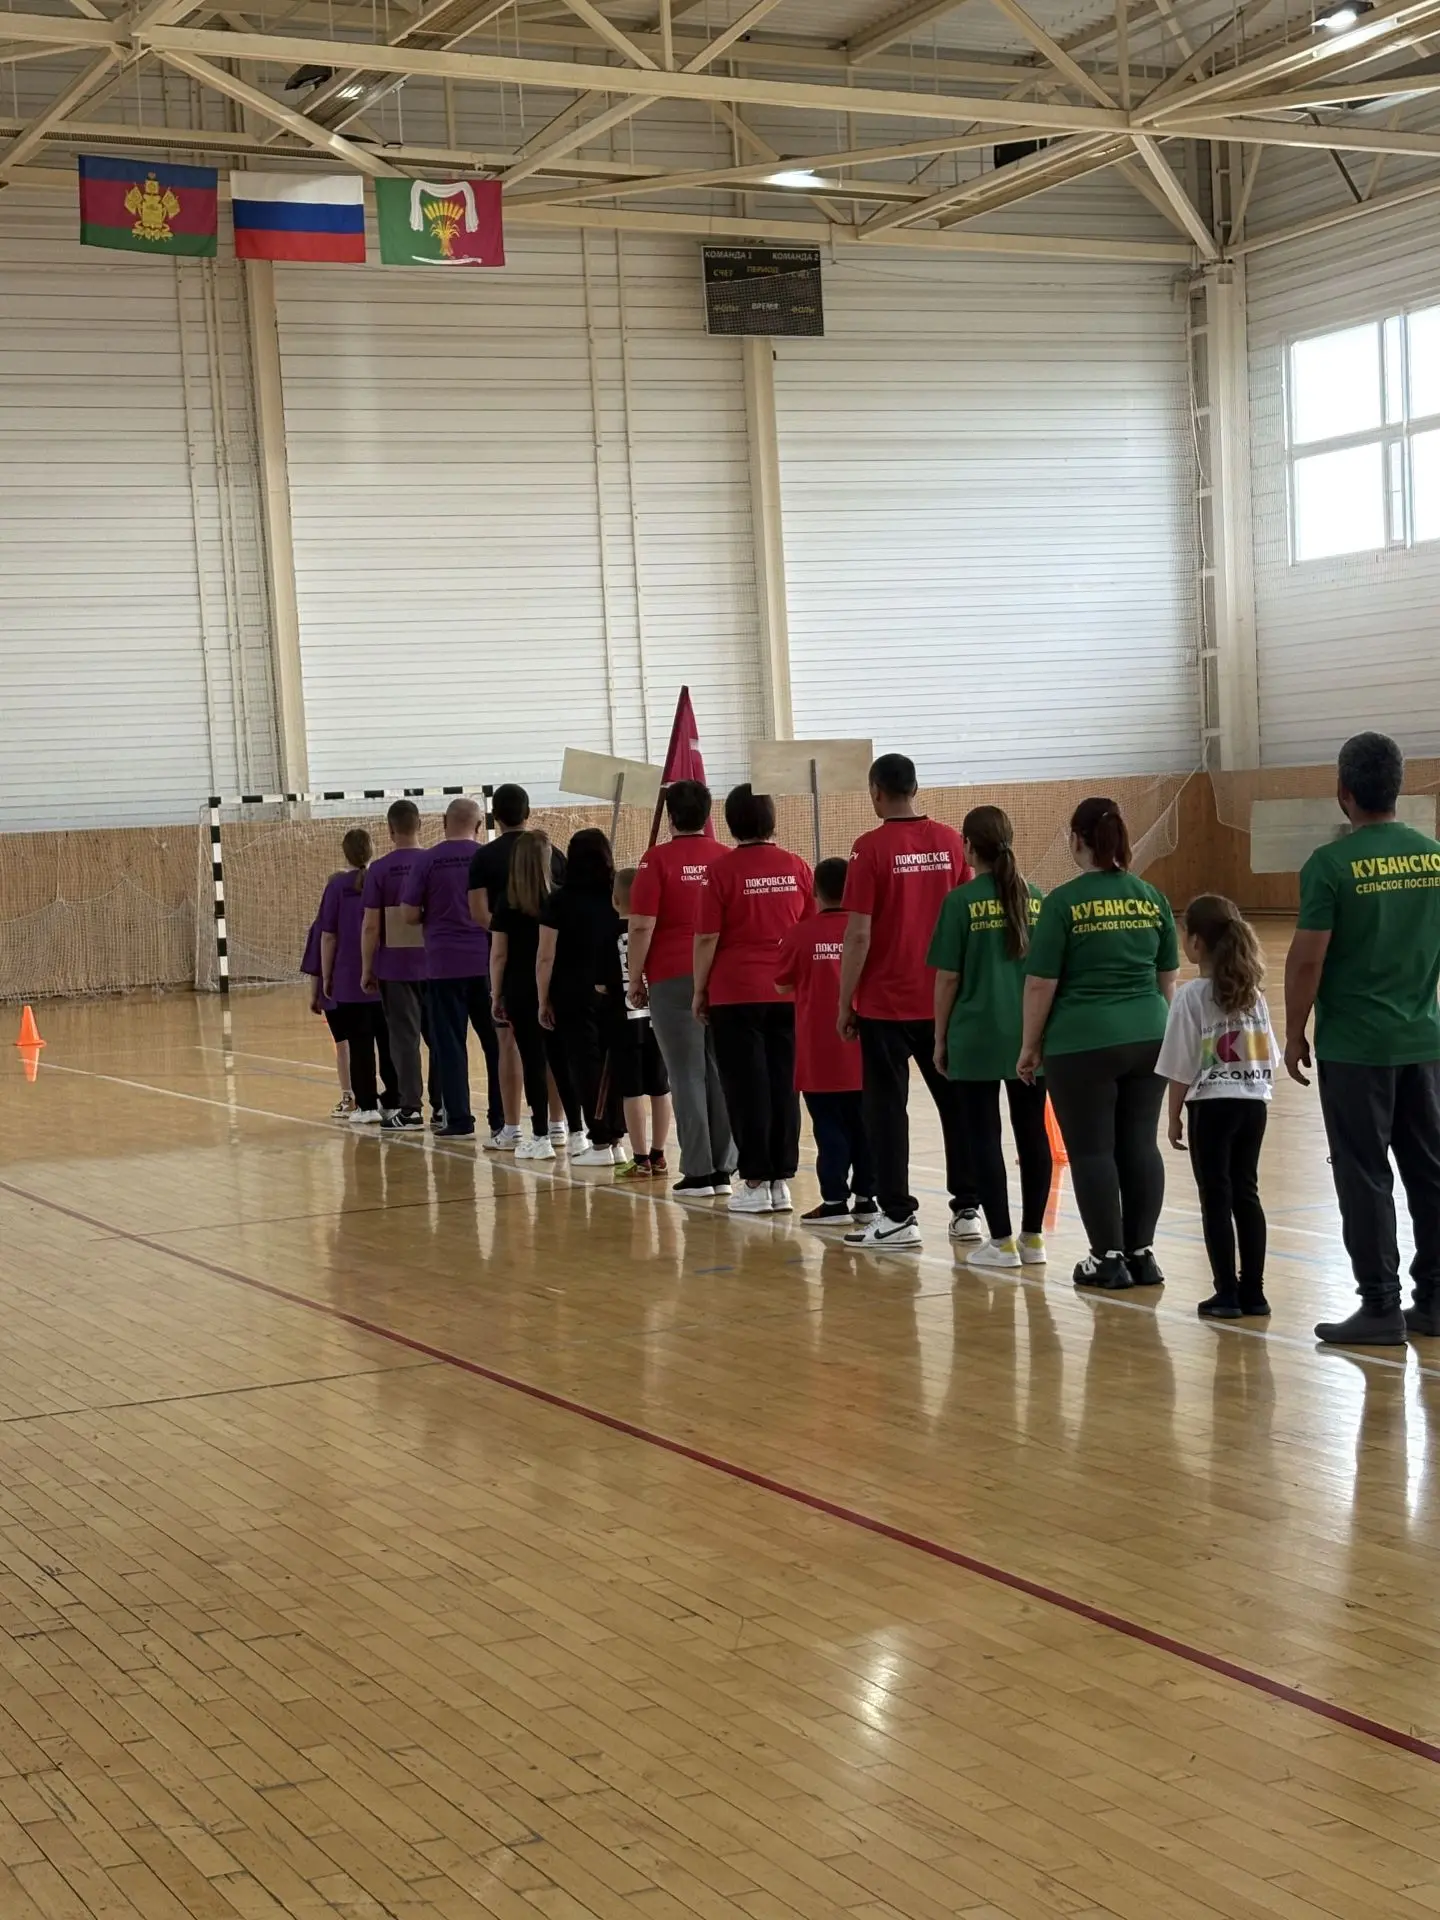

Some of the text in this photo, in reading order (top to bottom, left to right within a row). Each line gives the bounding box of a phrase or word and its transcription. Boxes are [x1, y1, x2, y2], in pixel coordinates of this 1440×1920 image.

[705, 250, 745, 259] КОМАНДА
[772, 252, 812, 260] КОМАНДА
[751, 302, 779, 310] ВРЕМЯ
[895, 851, 950, 865] ПОКРОВСКОЕ
[1351, 853, 1440, 879] КУБАНСКО
[745, 875, 797, 888] ПОКРОВСКОЕ
[1356, 880, 1403, 894] СЕЛЬСКОЕ
[1072, 920, 1119, 934] СЕЛЬСКОЕ
